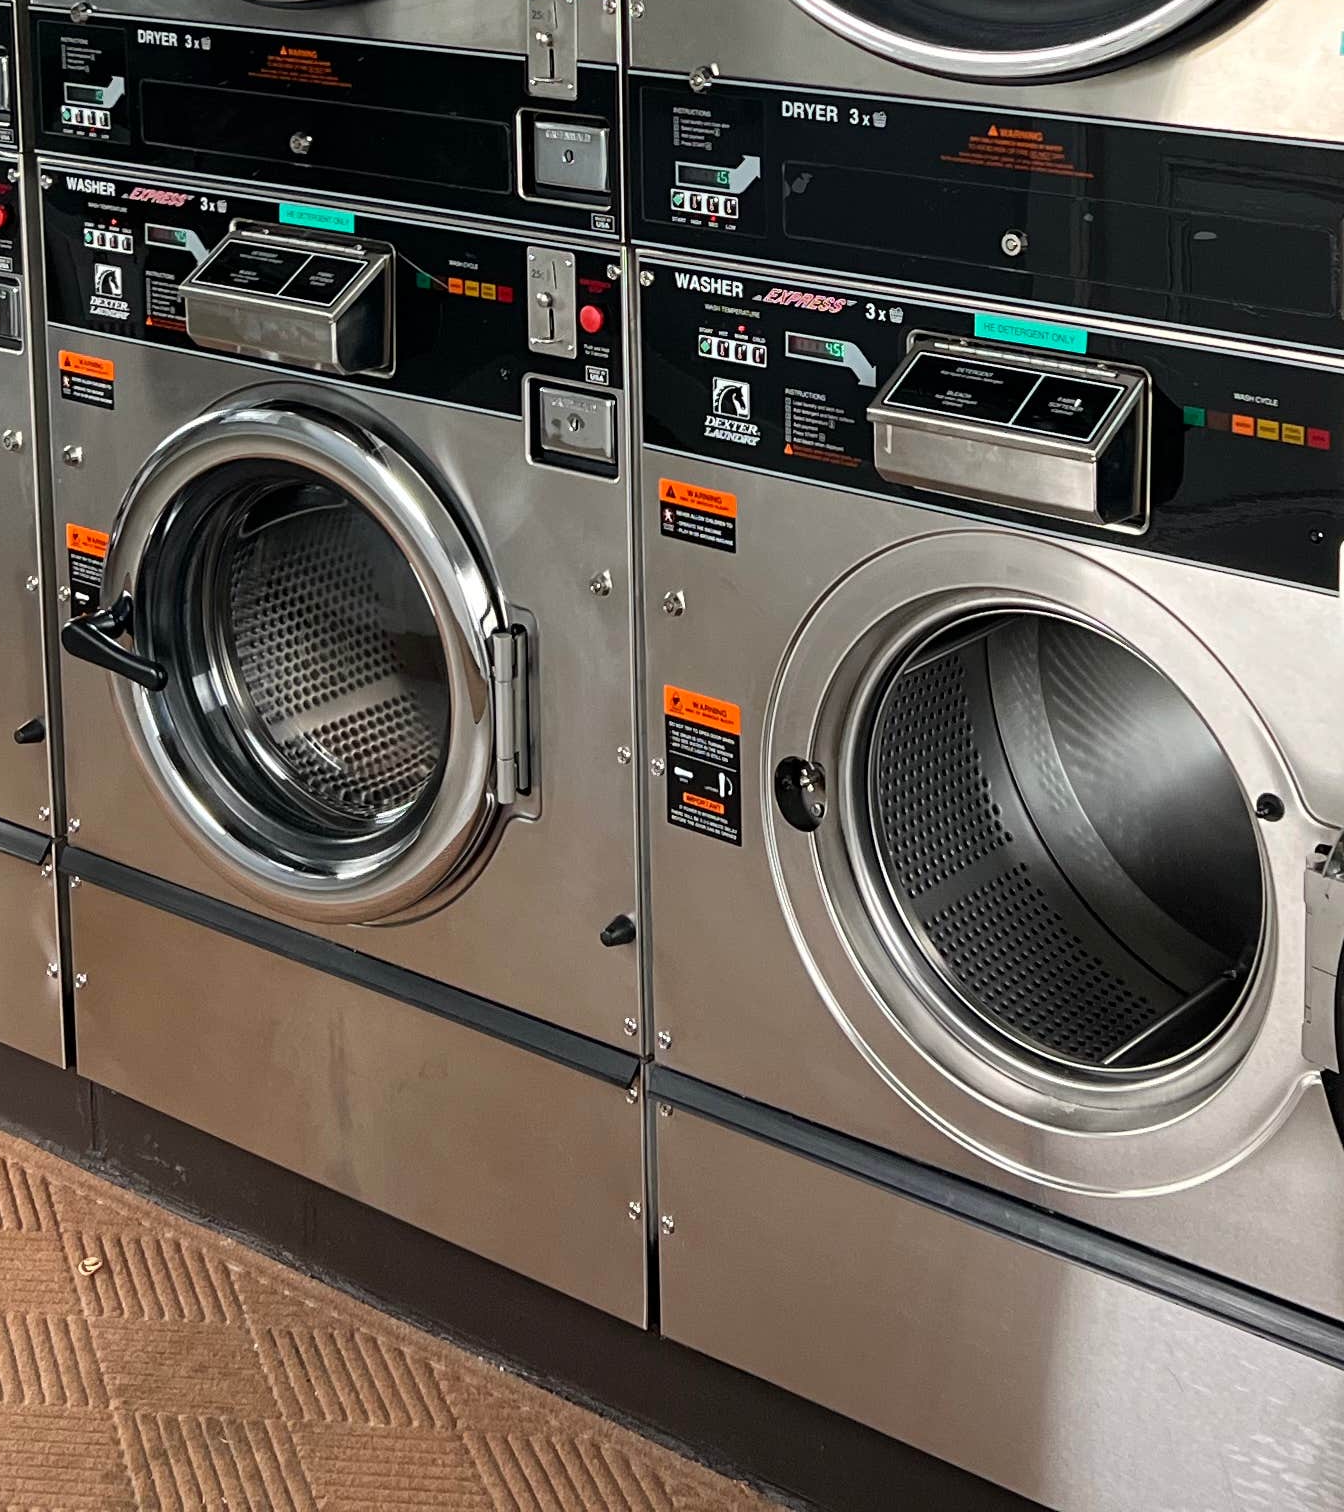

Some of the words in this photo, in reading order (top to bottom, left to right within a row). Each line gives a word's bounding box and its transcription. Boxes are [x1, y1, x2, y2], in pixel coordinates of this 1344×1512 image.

[138, 30, 177, 47] DRYER
[185, 34, 192, 48] 3
[782, 100, 838, 122] DRYER
[849, 108, 859, 125] 3
[862, 115, 870, 126] x
[66, 176, 116, 197] WASHER
[129, 187, 188, 207] EXPRESS
[200, 197, 208, 211] 3
[209, 202, 216, 212] x
[90, 296, 129, 311] DEXTER
[674, 272, 743, 298] WASHER
[763, 288, 847, 313] EXPRESS
[865, 303, 876, 319] 3
[878, 310, 886, 321] x
[983, 322, 994, 332] HE
[997, 326, 1050, 341] DETERGENT
[1052, 333, 1075, 345] ONLY
[705, 416, 758, 435] DEXTER
[704, 428, 760, 446] LAUNDRY
